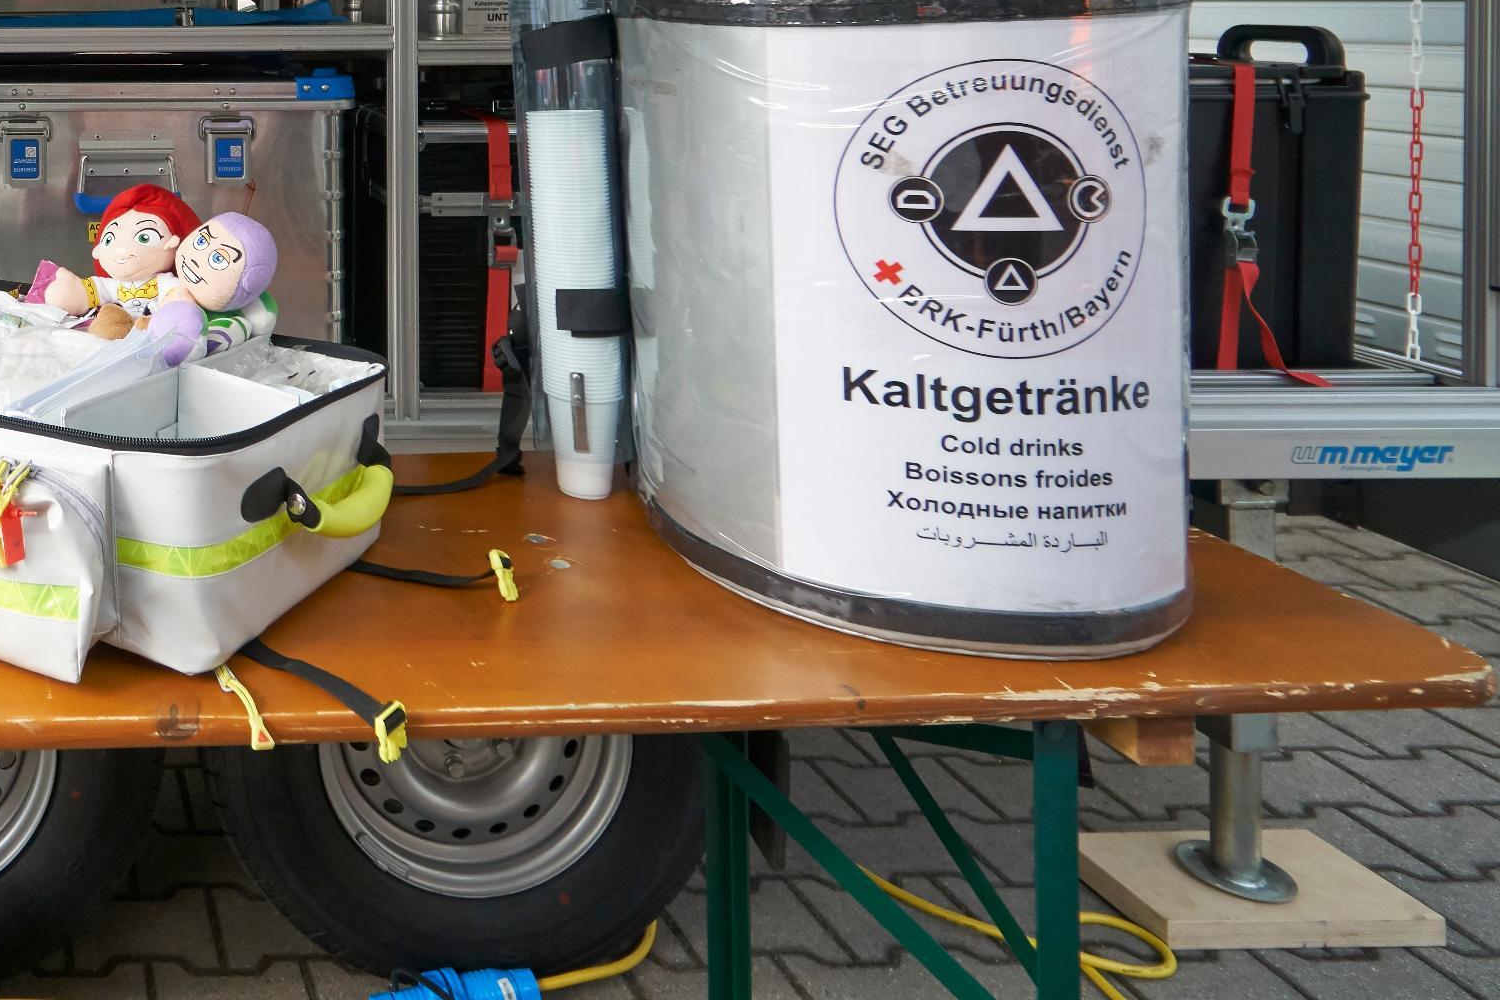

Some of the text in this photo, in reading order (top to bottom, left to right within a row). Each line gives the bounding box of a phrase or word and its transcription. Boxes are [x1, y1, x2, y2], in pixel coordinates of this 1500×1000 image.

[487, 12, 509, 22] UNT
[860, 73, 1131, 170] SEG Betreuungsdienst
[897, 249, 1132, 343] BRK-Fürth/Bayern
[842, 365, 1150, 423] Kaltgetränke
[941, 434, 1084, 457] Cold drinks
[905, 461, 1113, 488] Boissons froides
[887, 489, 1127, 520] Холодные напитки
